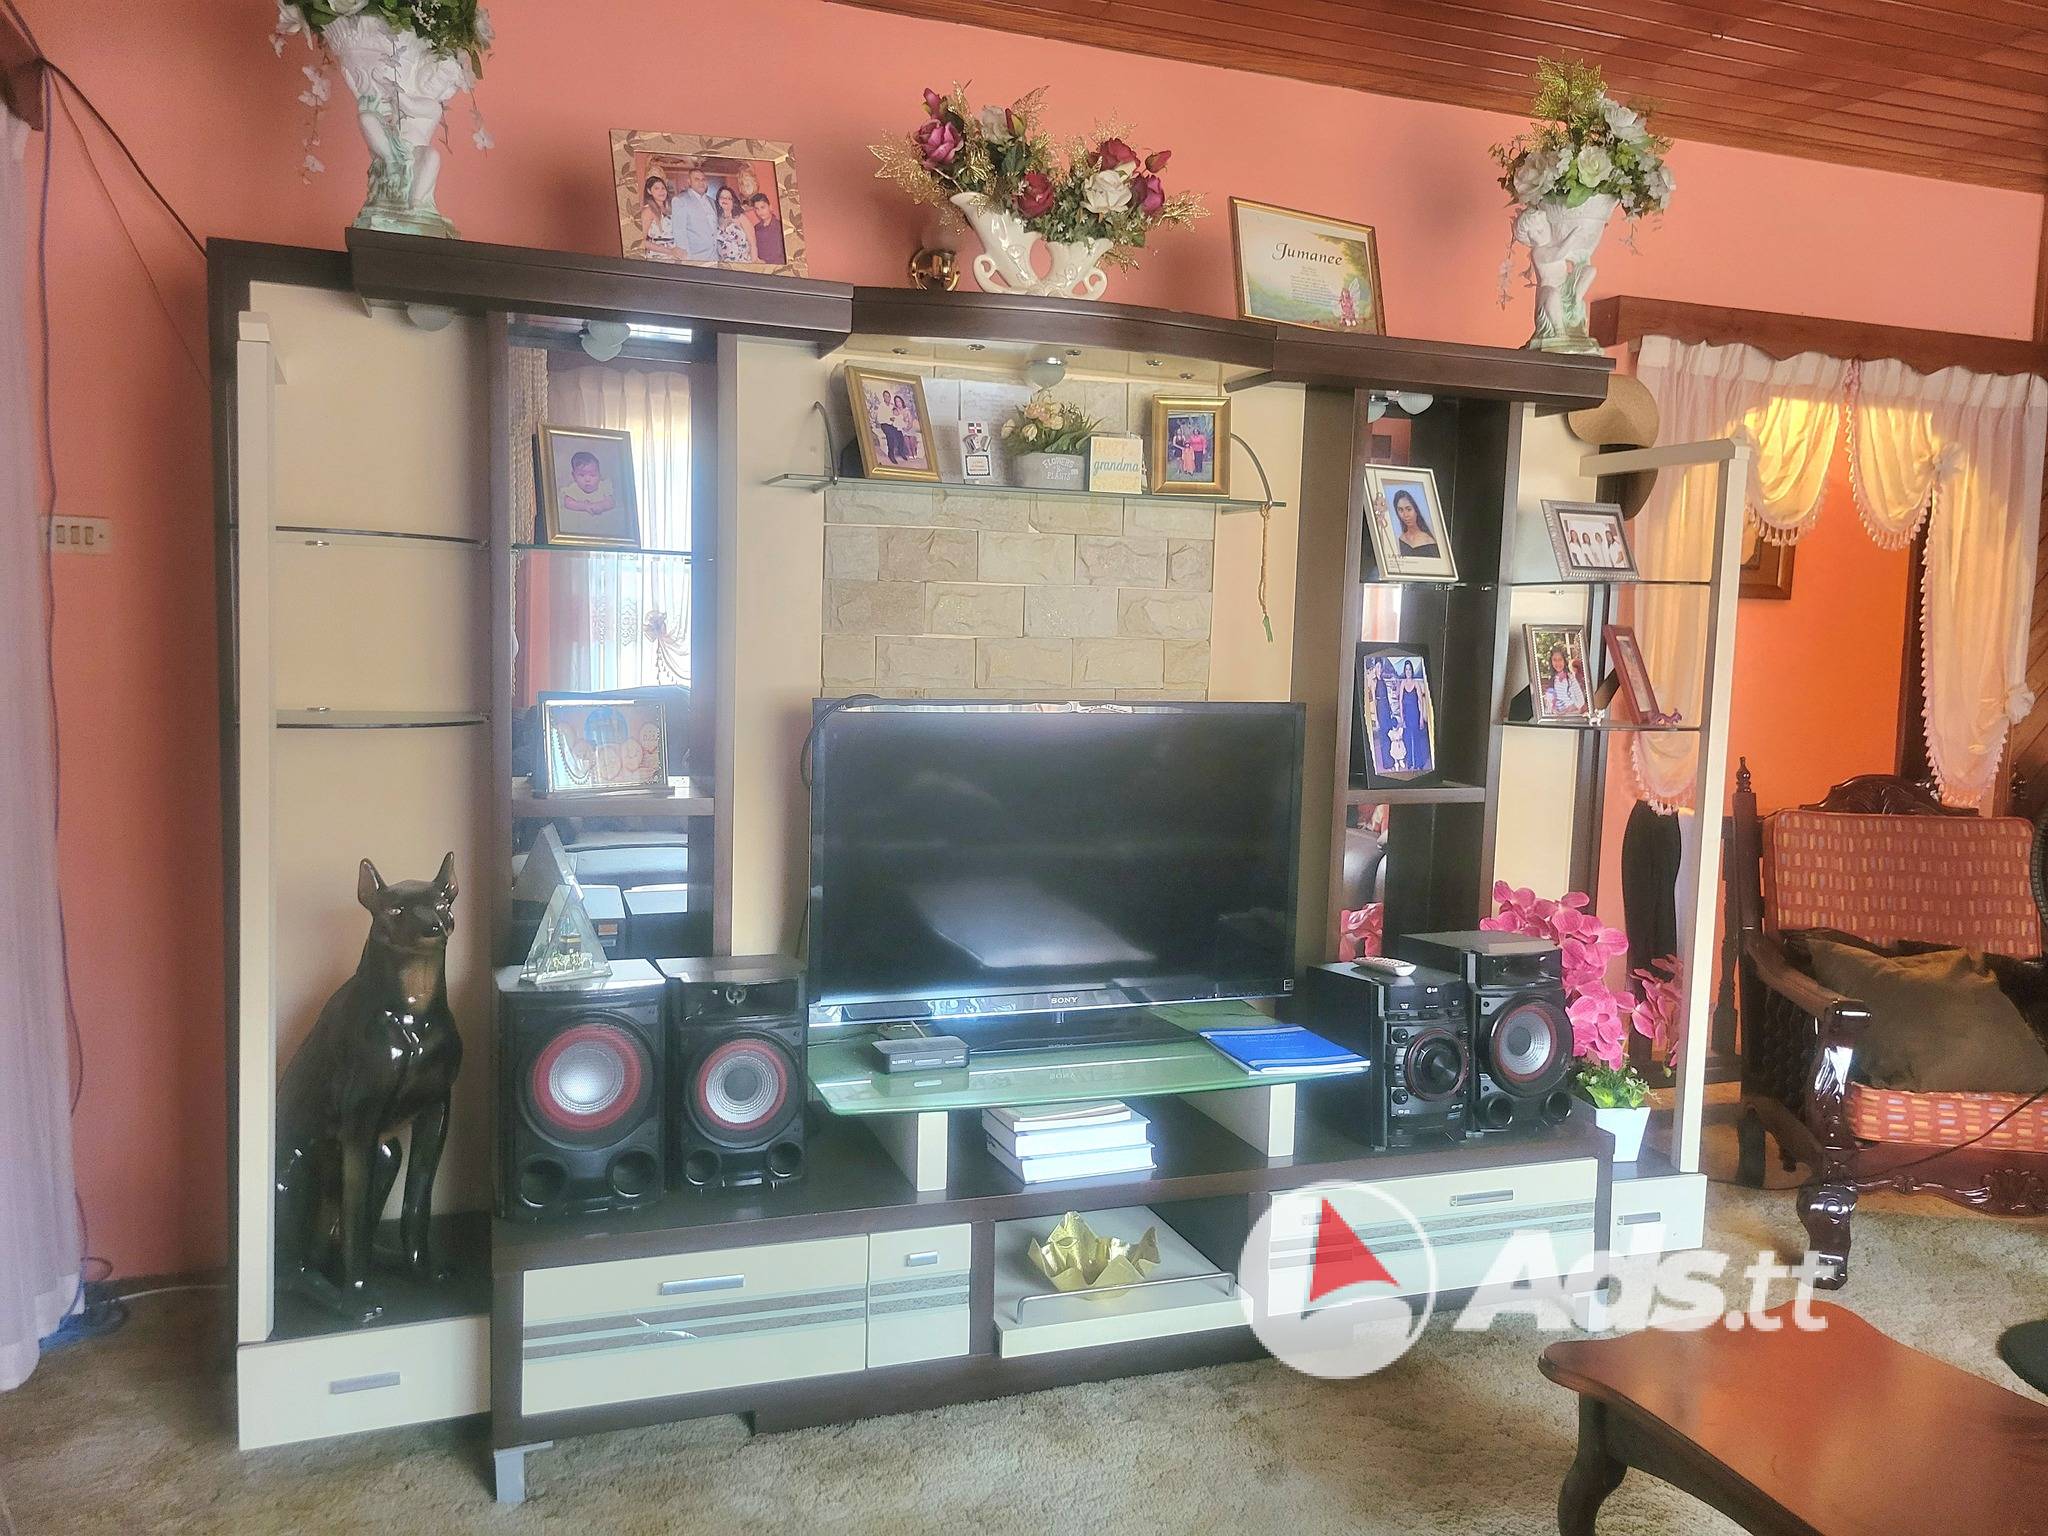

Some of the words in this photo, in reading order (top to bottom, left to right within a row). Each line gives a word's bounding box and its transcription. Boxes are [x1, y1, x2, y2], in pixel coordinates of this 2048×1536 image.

[1042, 456, 1075, 469] FLOWERS
[1093, 457, 1140, 476] grandma
[1047, 471, 1070, 481] PLANTS
[1051, 996, 1078, 1004] SONY
